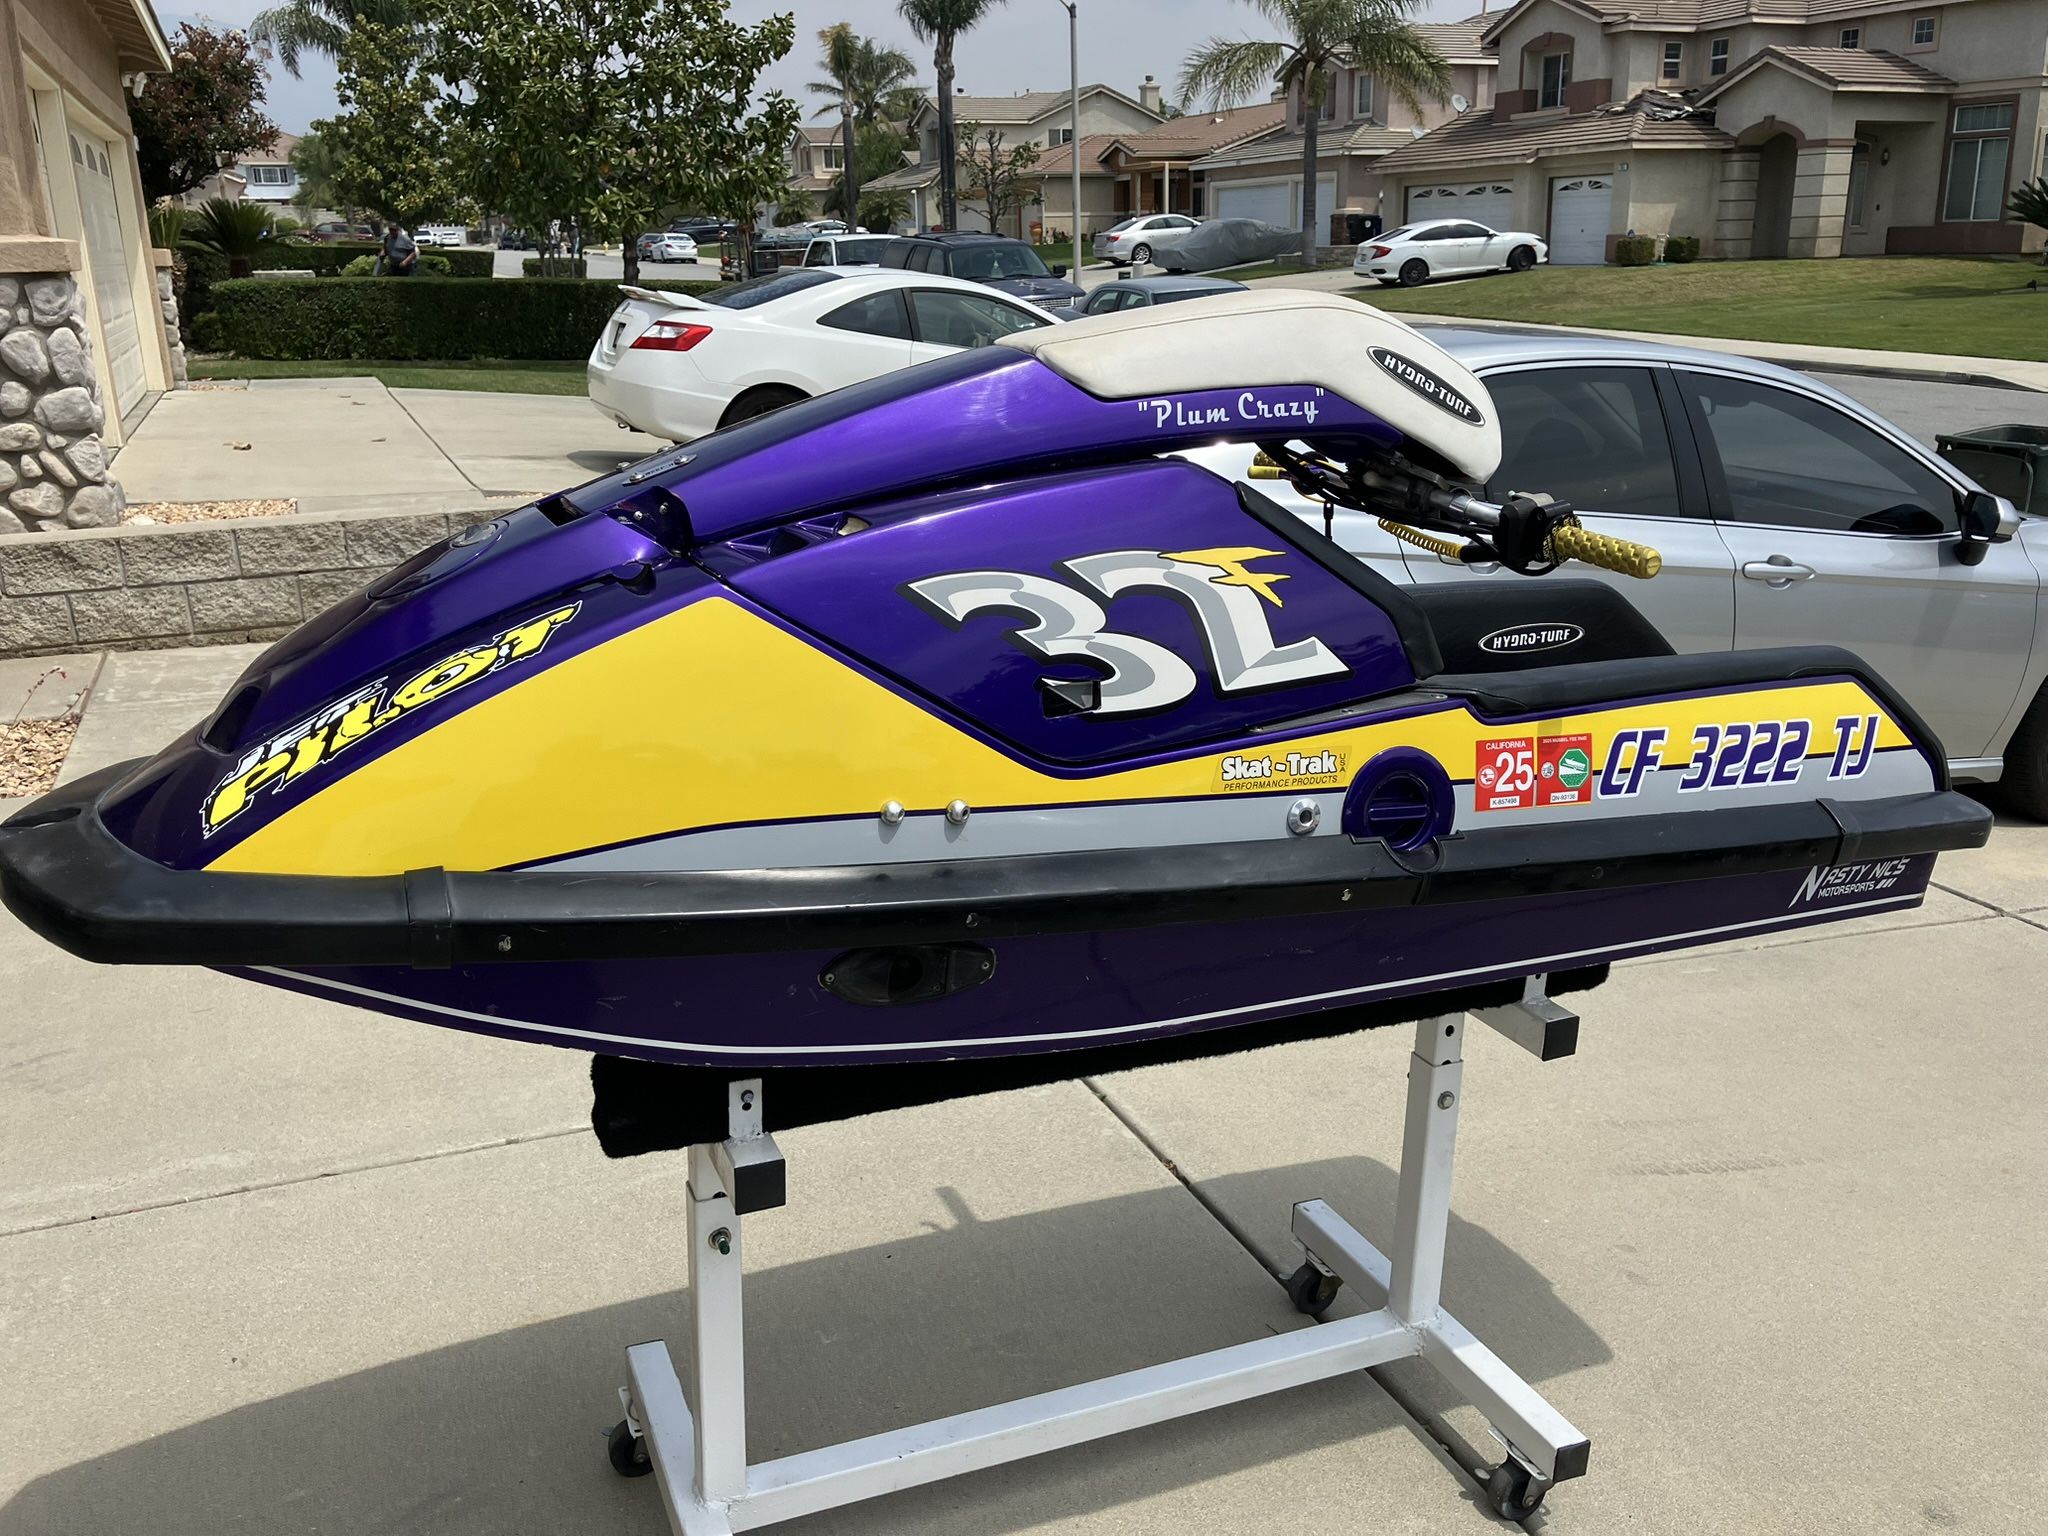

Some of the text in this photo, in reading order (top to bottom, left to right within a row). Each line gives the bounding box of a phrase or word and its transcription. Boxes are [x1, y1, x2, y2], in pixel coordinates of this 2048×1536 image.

[1383, 354, 1473, 417] HYDRO-TURF
[1493, 628, 1571, 649] HYDRO-TURF
[1485, 740, 1527, 751] CALIFORNIA
[1597, 713, 1882, 799] CF 3222 TJ
[1224, 774, 1338, 792] PERFORMANCE PRODUCTS
[1495, 750, 1534, 793] 25
[1787, 864, 1872, 909] NASTY
[1817, 880, 1876, 899] MOTORSPORTS
